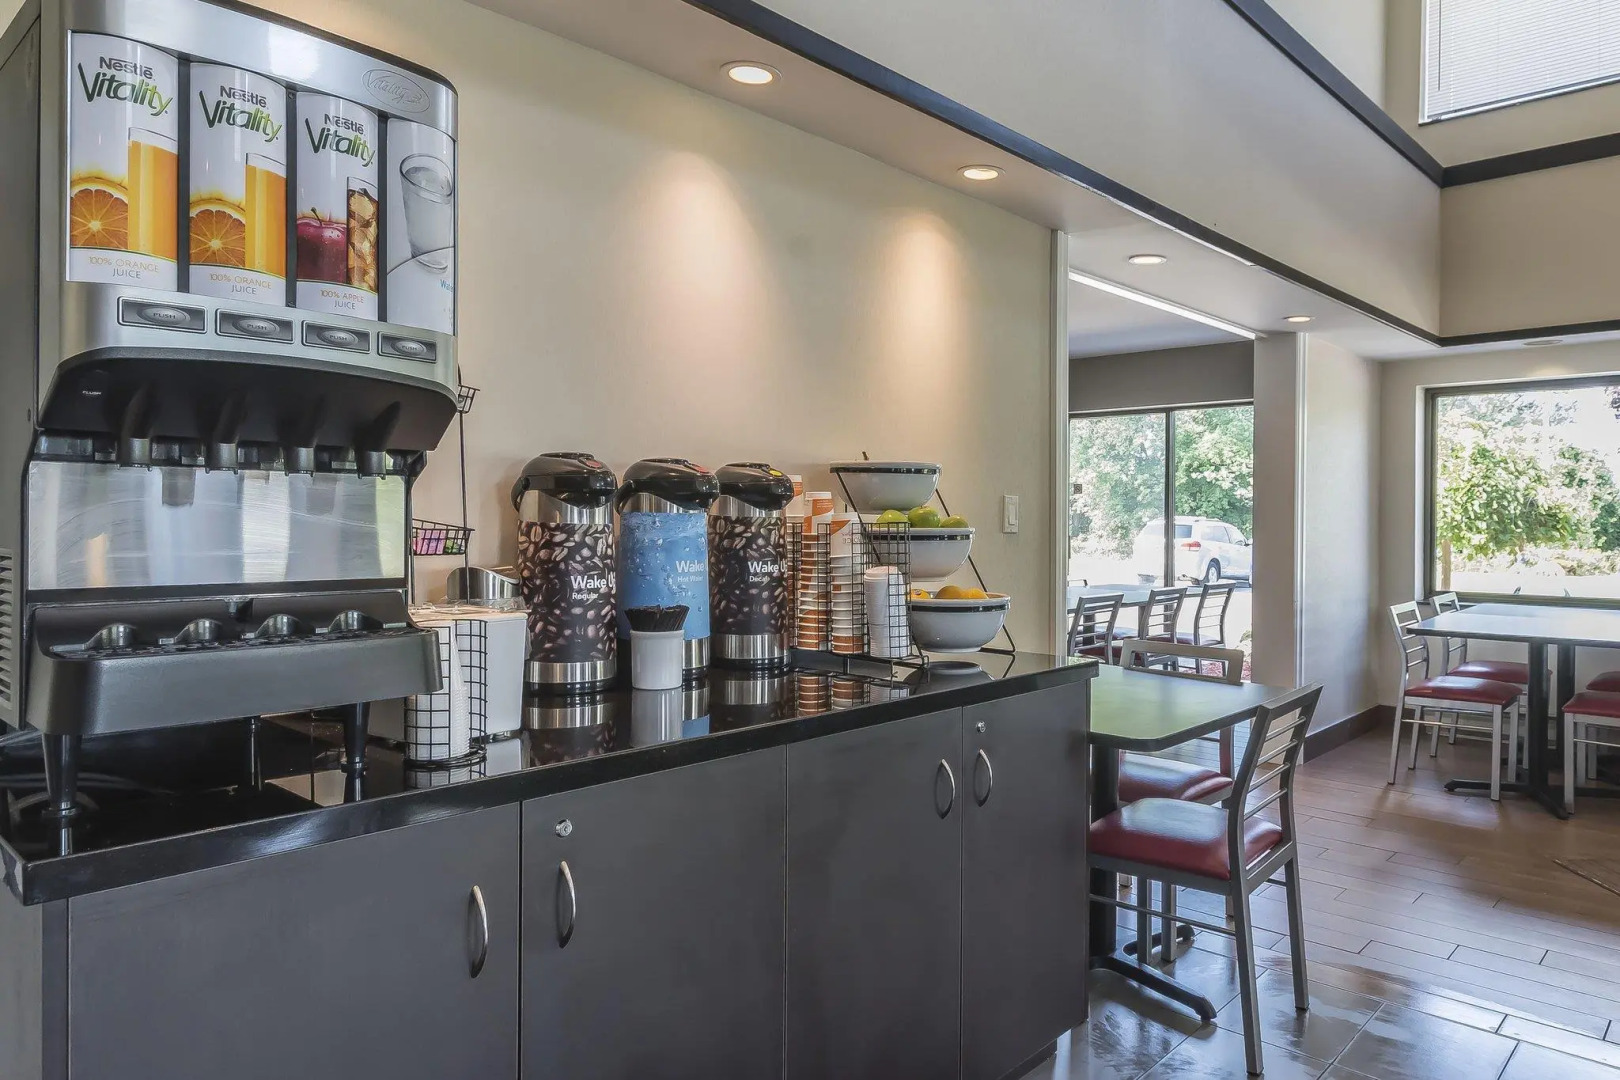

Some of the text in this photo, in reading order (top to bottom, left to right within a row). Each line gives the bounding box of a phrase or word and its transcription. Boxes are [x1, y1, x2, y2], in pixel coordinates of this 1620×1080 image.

[78, 62, 173, 117] Vitality
[199, 90, 283, 143] Vitality
[304, 117, 376, 168] Vitality
[88, 256, 160, 273] 100% ORANGE
[112, 268, 142, 279] JUICE
[209, 273, 273, 290] 100% ORANGE
[231, 284, 257, 295] JUICE
[320, 289, 364, 304] 100% APPLE
[334, 300, 356, 310] JUICE
[153, 312, 176, 320] PUSH
[246, 323, 268, 331] PUSH
[675, 559, 705, 573] Wake
[747, 560, 780, 573] Wake
[570, 575, 607, 589] Wake
[572, 592, 599, 601] Regular
